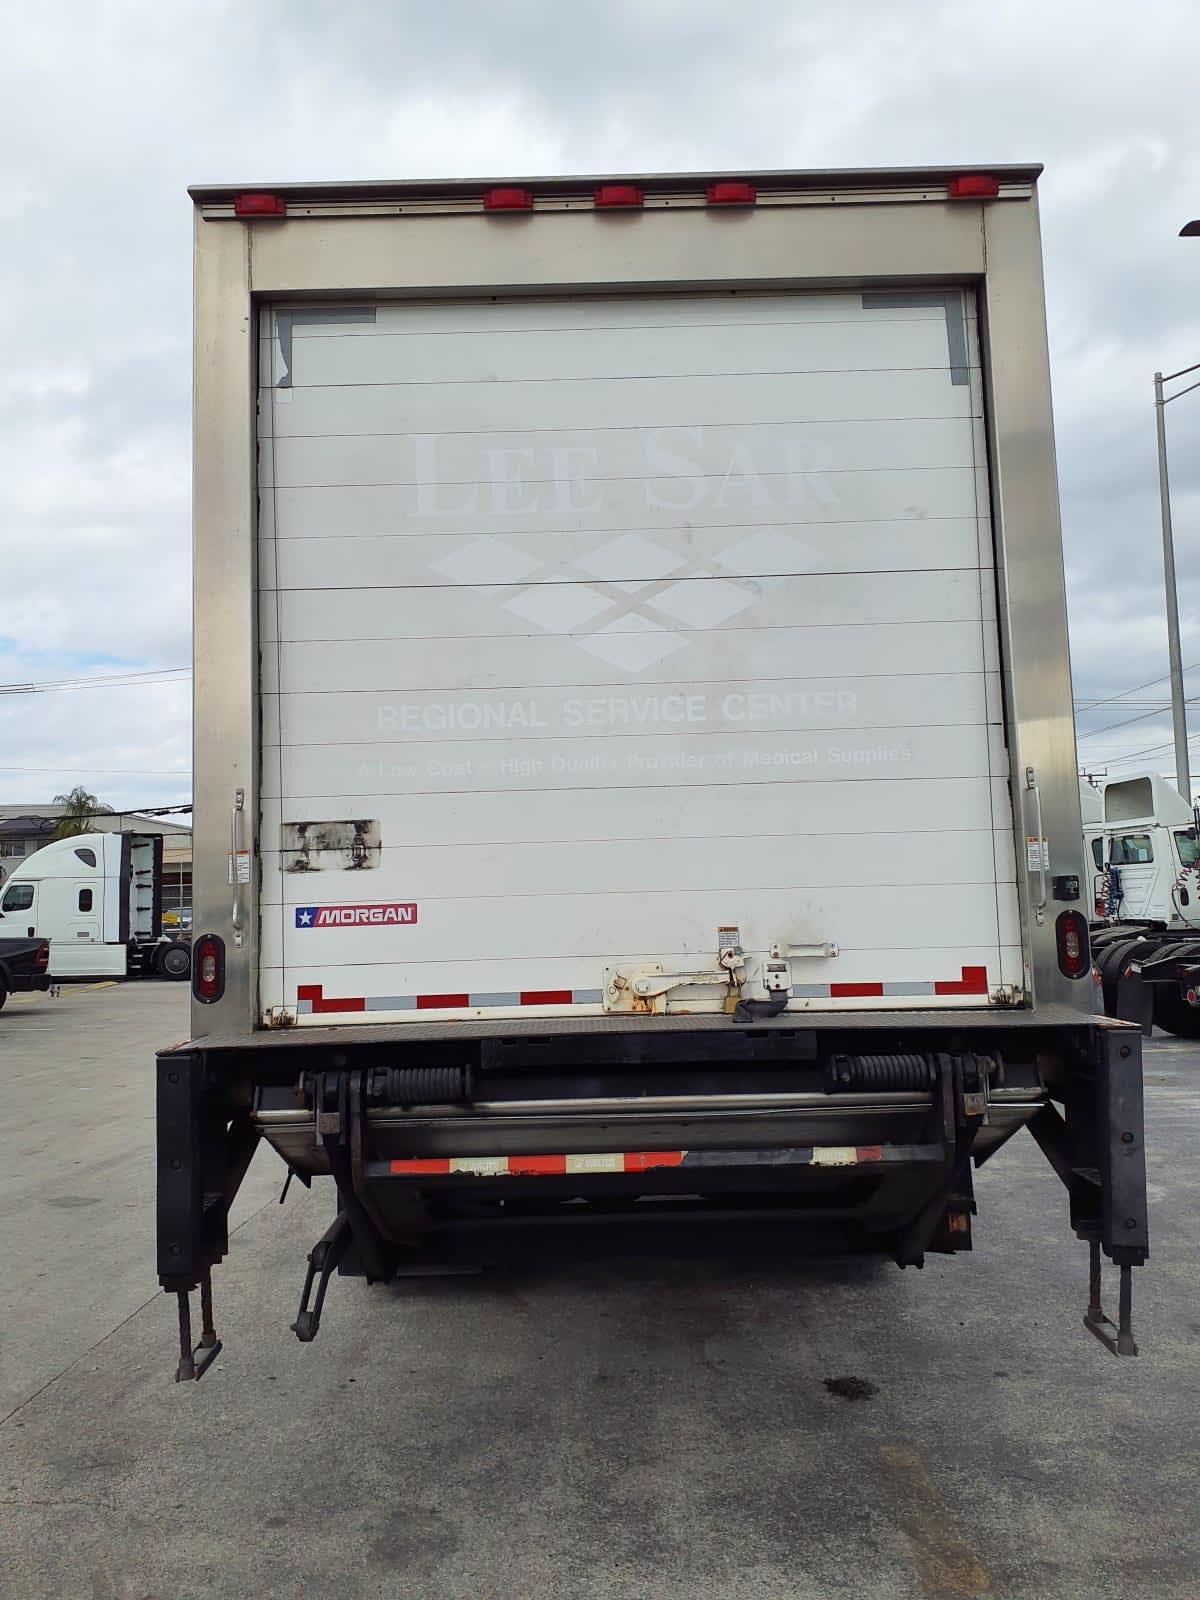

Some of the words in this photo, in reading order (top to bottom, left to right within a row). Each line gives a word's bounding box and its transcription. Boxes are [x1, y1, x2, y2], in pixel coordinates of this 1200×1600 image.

[376, 698, 549, 730] REGIONAL
[562, 694, 707, 728] SERVICE
[721, 689, 858, 722] CENTER
[500, 756, 543, 777] High
[743, 748, 817, 769] Medical
[828, 744, 912, 766] Supplies
[318, 907, 412, 924] MORGAN
